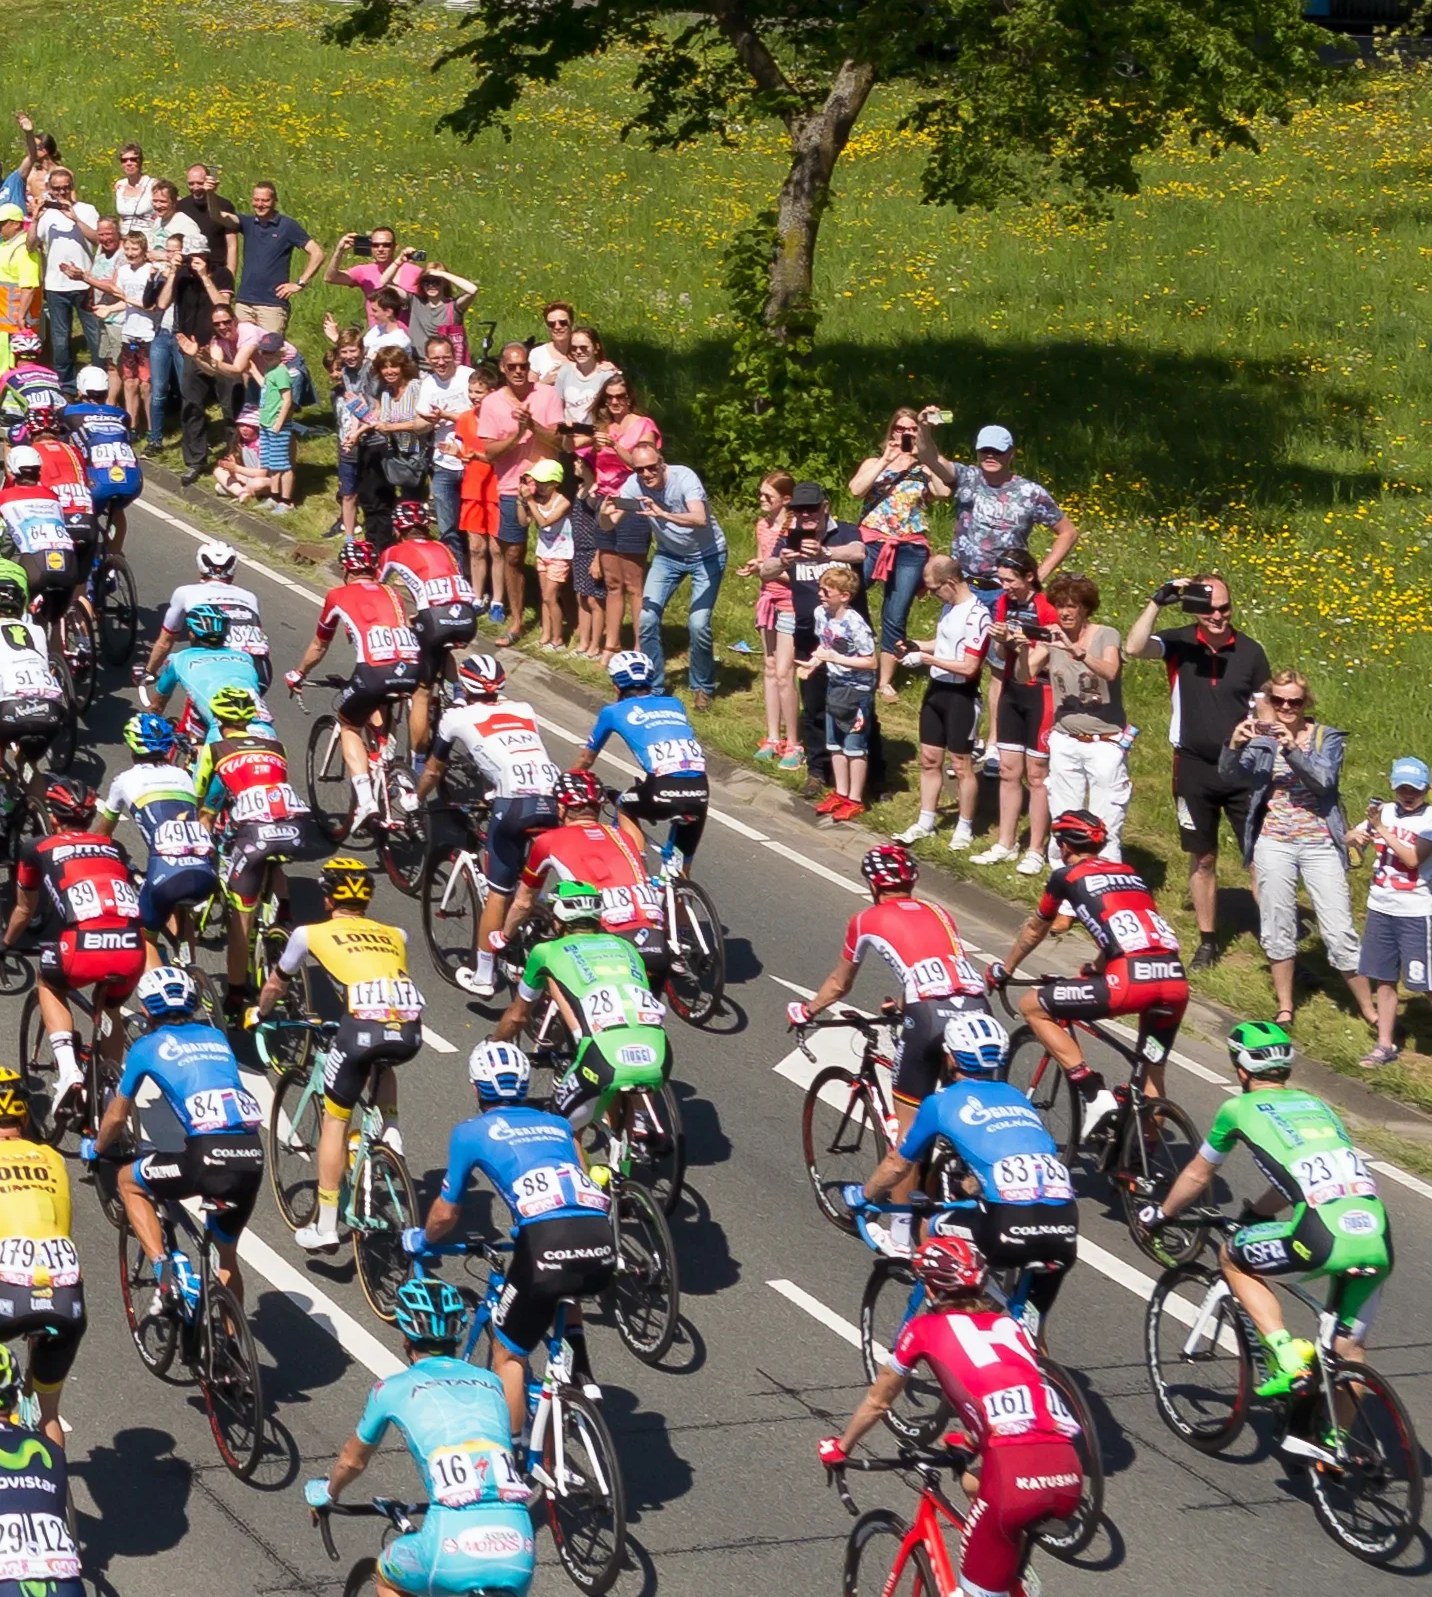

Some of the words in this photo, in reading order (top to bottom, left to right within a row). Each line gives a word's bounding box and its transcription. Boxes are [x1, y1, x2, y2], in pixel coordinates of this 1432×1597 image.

[52, 844, 119, 860] BMC
[1085, 874, 1146, 892] BMC
[72, 884, 95, 906] 39
[1113, 913, 1140, 936] 33
[84, 932, 137, 950] BMC
[1134, 961, 1183, 979] BMC
[355, 982, 385, 1005] 171
[589, 991, 614, 1015] 28
[1053, 985, 1095, 1001] BMC
[193, 1095, 220, 1119] 84
[1001, 1159, 1028, 1184] 83
[1301, 1156, 1333, 1186] 23
[522, 1171, 550, 1197] 88
[1009, 1224, 1076, 1236] COLNAGO
[41, 1238, 76, 1269] 179
[543, 1245, 613, 1261] COLNAGO
[989, 1389, 1030, 1417] 161
[437, 1456, 467, 1488] 16
[1015, 1473, 1081, 1490] KATUSHA
